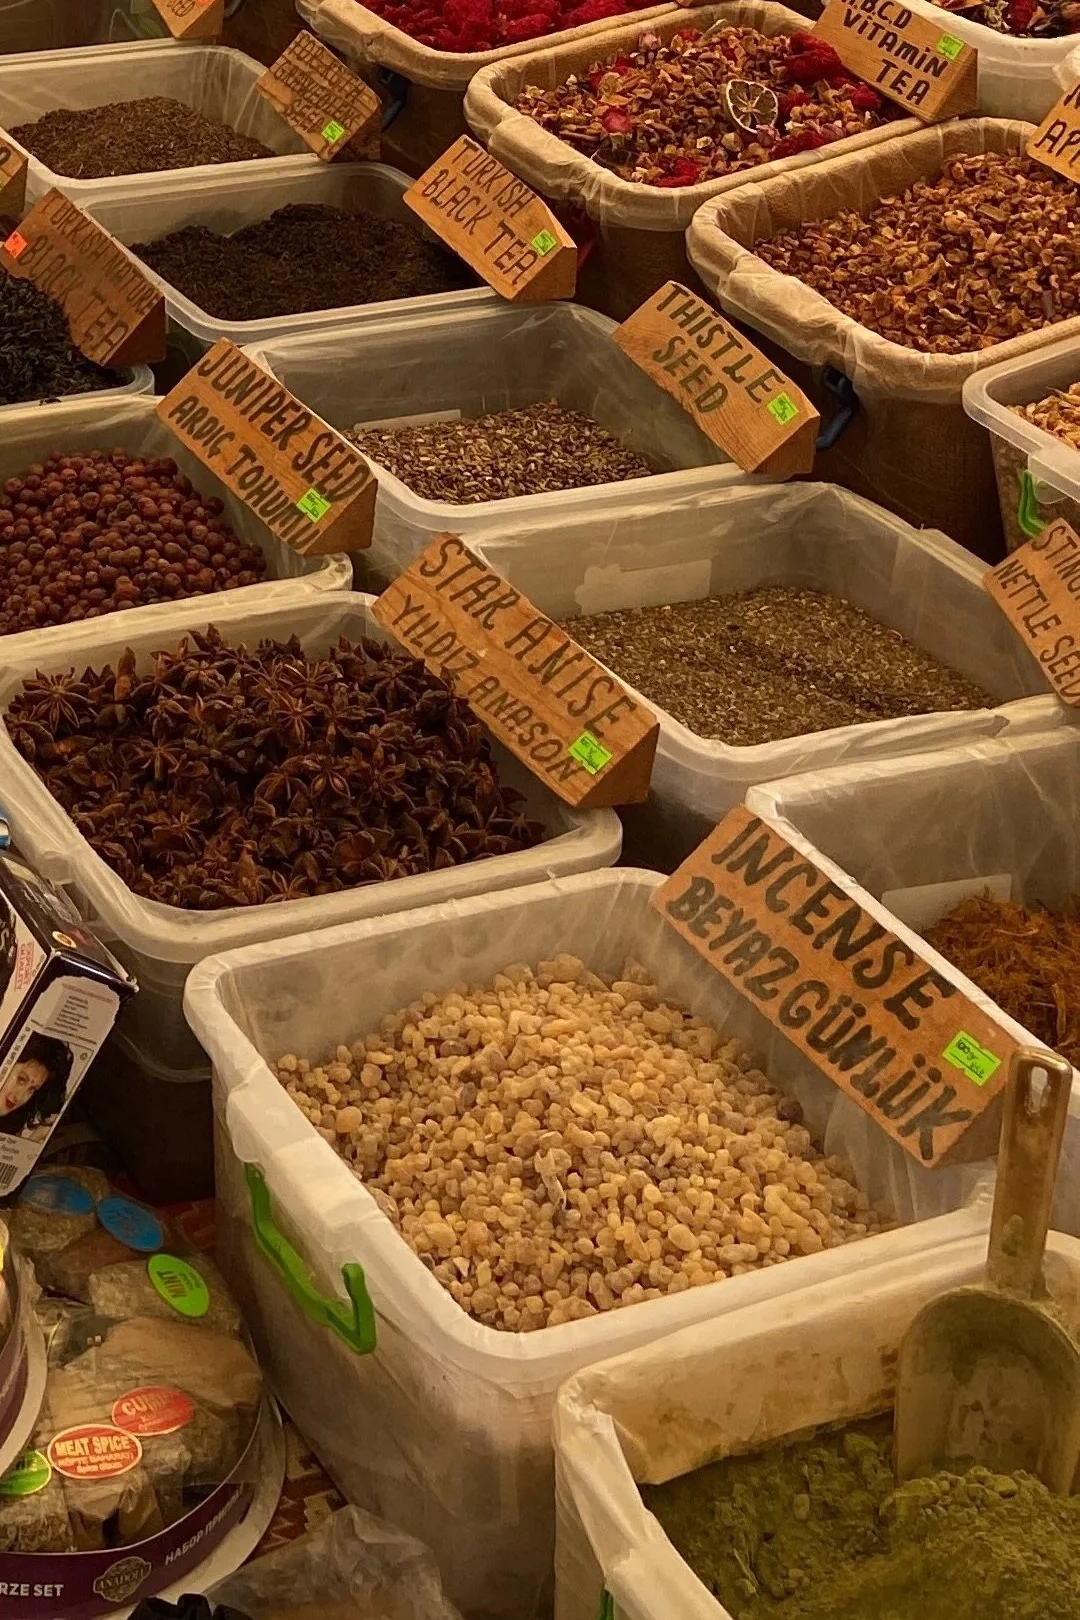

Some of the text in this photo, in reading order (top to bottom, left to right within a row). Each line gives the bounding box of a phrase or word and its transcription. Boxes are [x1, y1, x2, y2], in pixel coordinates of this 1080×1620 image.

[876, 58, 931, 106] TEA
[421, 168, 493, 236] BLACK
[452, 138, 538, 219] TURKISH
[37, 194, 107, 264] TURKISH
[483, 218, 539, 286] TEA
[18, 234, 130, 367] BLACK TEA
[651, 335, 729, 414] SEED
[196, 346, 372, 503] JUNIPER SEED
[419, 537, 638, 739] STAR ANISE
[992, 558, 1063, 640] NETTLE
[391, 593, 586, 782] YILDIZ ANASON
[710, 816, 957, 1032] INCENSE
[55, 1435, 131, 1457] MEAT SPICE
[33, 1583, 65, 1598] SET
